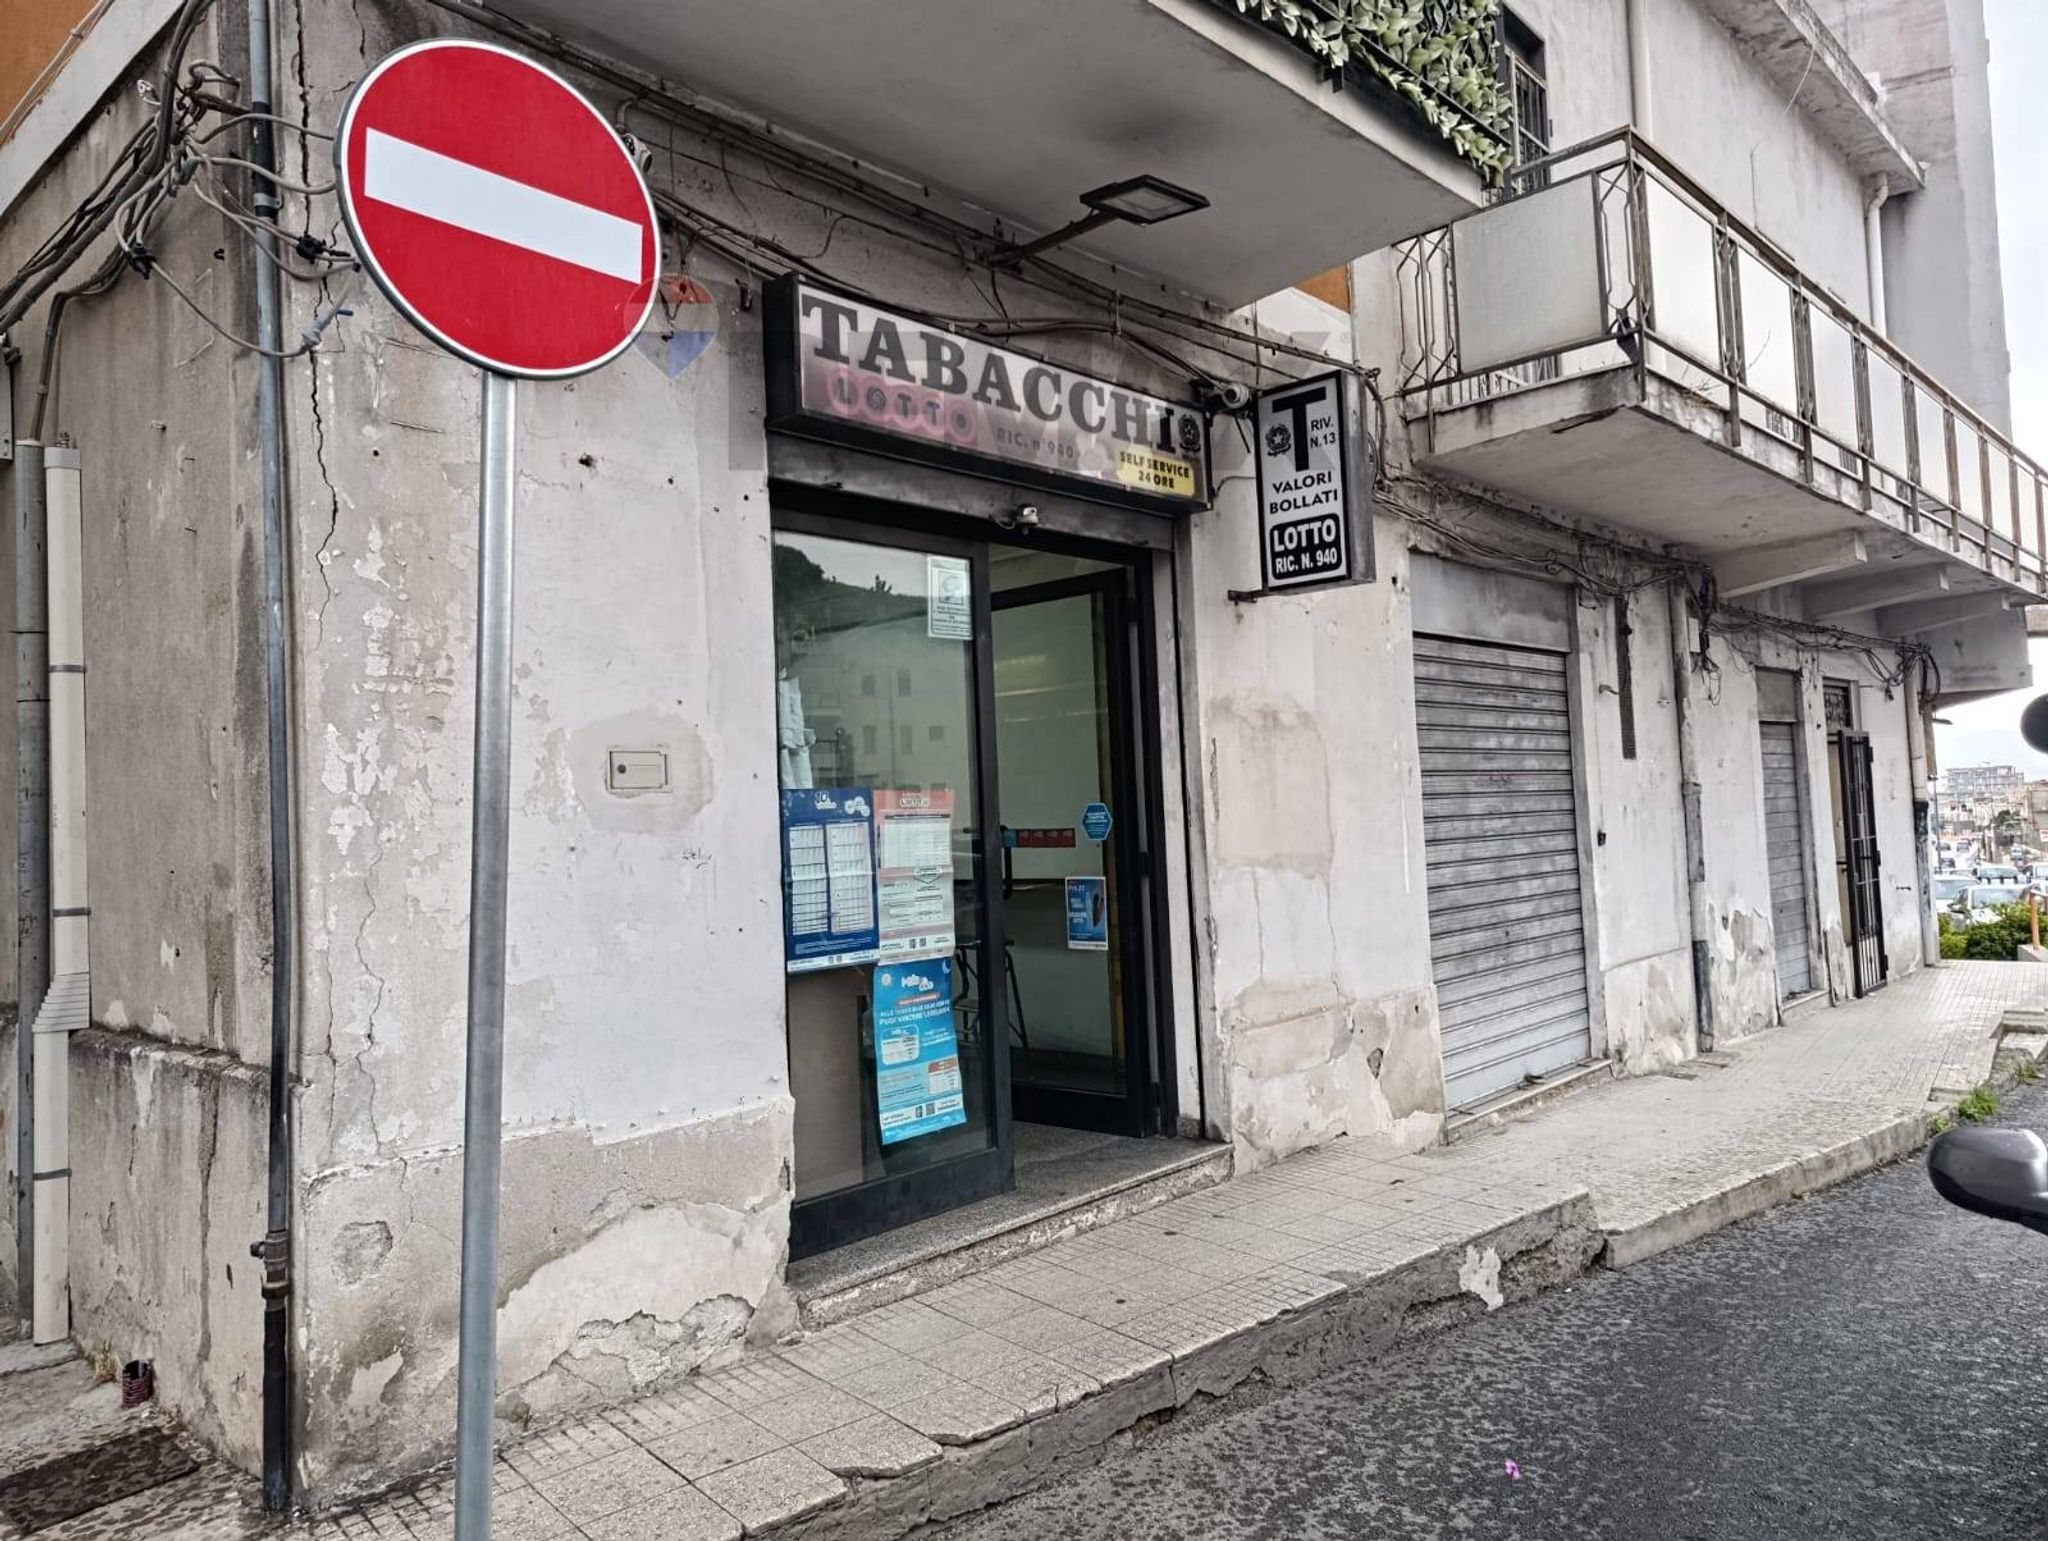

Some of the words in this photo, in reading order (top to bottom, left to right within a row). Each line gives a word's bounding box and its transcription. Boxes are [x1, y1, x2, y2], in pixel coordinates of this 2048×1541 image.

[802, 293, 1176, 454] TABACCHI
[834, 372, 974, 438] LOTTO
[1272, 386, 1327, 473] T
[1310, 416, 1334, 431] RIV.
[1120, 451, 1146, 468] SELF
[1147, 458, 1190, 479] SERVICE
[1138, 470, 1151, 483] 24
[1153, 474, 1175, 489] ORE
[1272, 470, 1332, 494] VALORI
[1269, 489, 1338, 514] BOLLATI
[1273, 518, 1337, 553] LOTTO
[1275, 555, 1299, 575] RIC.
[1301, 552, 1314, 570] N.
[1316, 547, 1338, 567] 940
